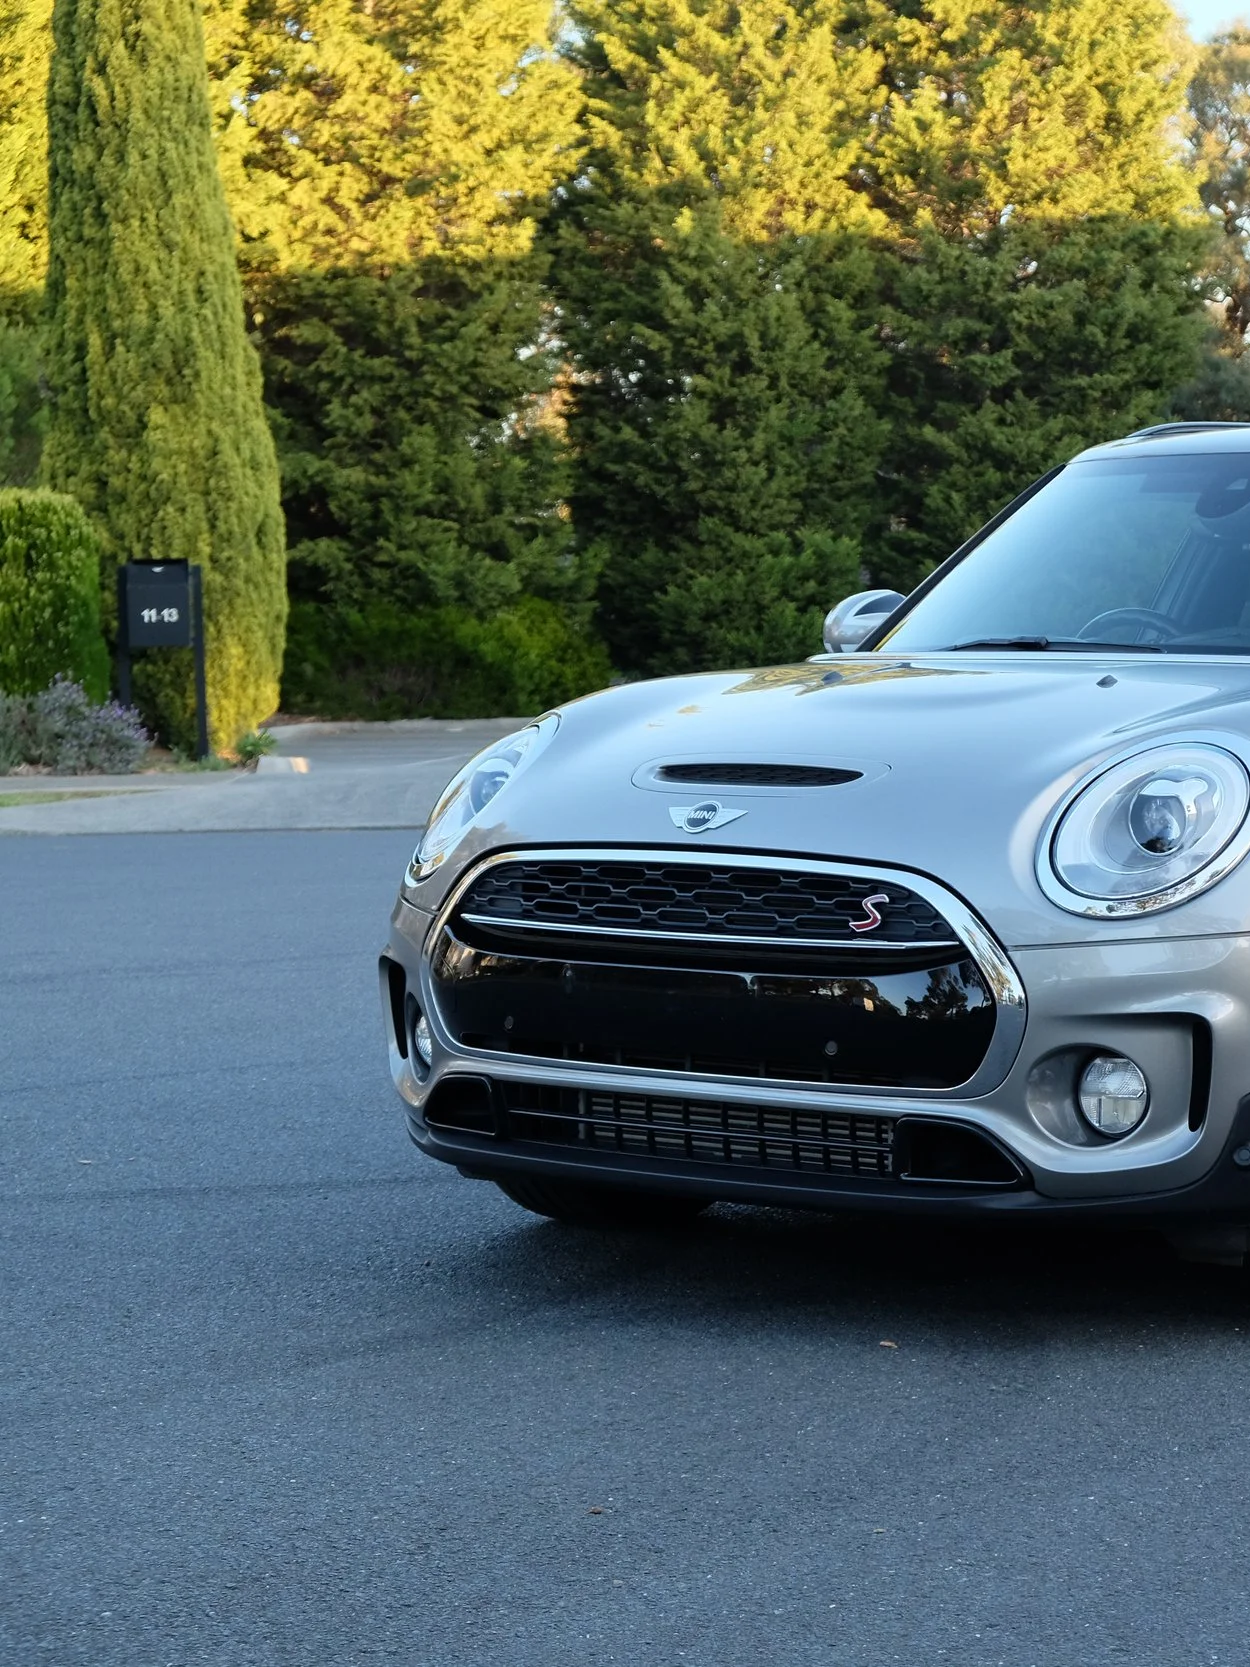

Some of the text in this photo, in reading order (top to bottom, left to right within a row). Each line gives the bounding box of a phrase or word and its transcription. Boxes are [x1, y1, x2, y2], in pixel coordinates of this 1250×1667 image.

[141, 608, 179, 624] 11-13
[687, 810, 716, 820] MINI
[849, 894, 889, 932] S
